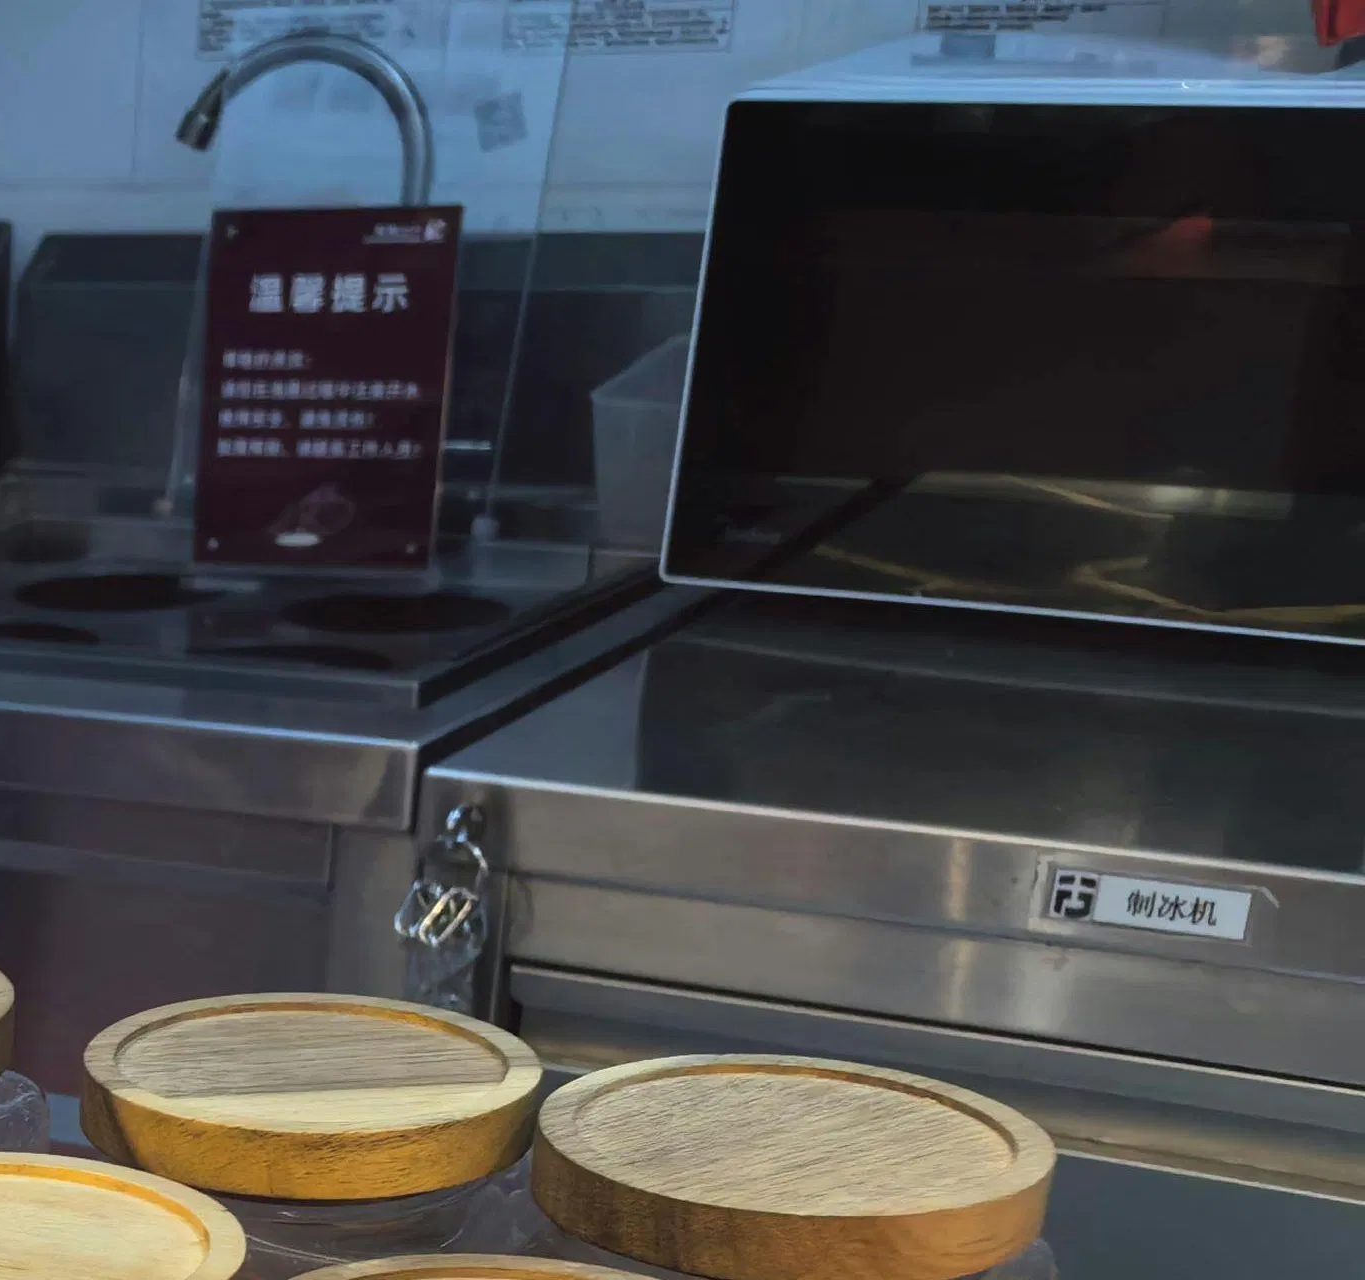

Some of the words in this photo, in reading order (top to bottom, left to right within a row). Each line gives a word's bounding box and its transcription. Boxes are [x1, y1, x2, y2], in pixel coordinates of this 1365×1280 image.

[249, 273, 409, 313] 温馨提示
[1127, 889, 1217, 926] 制冰机
